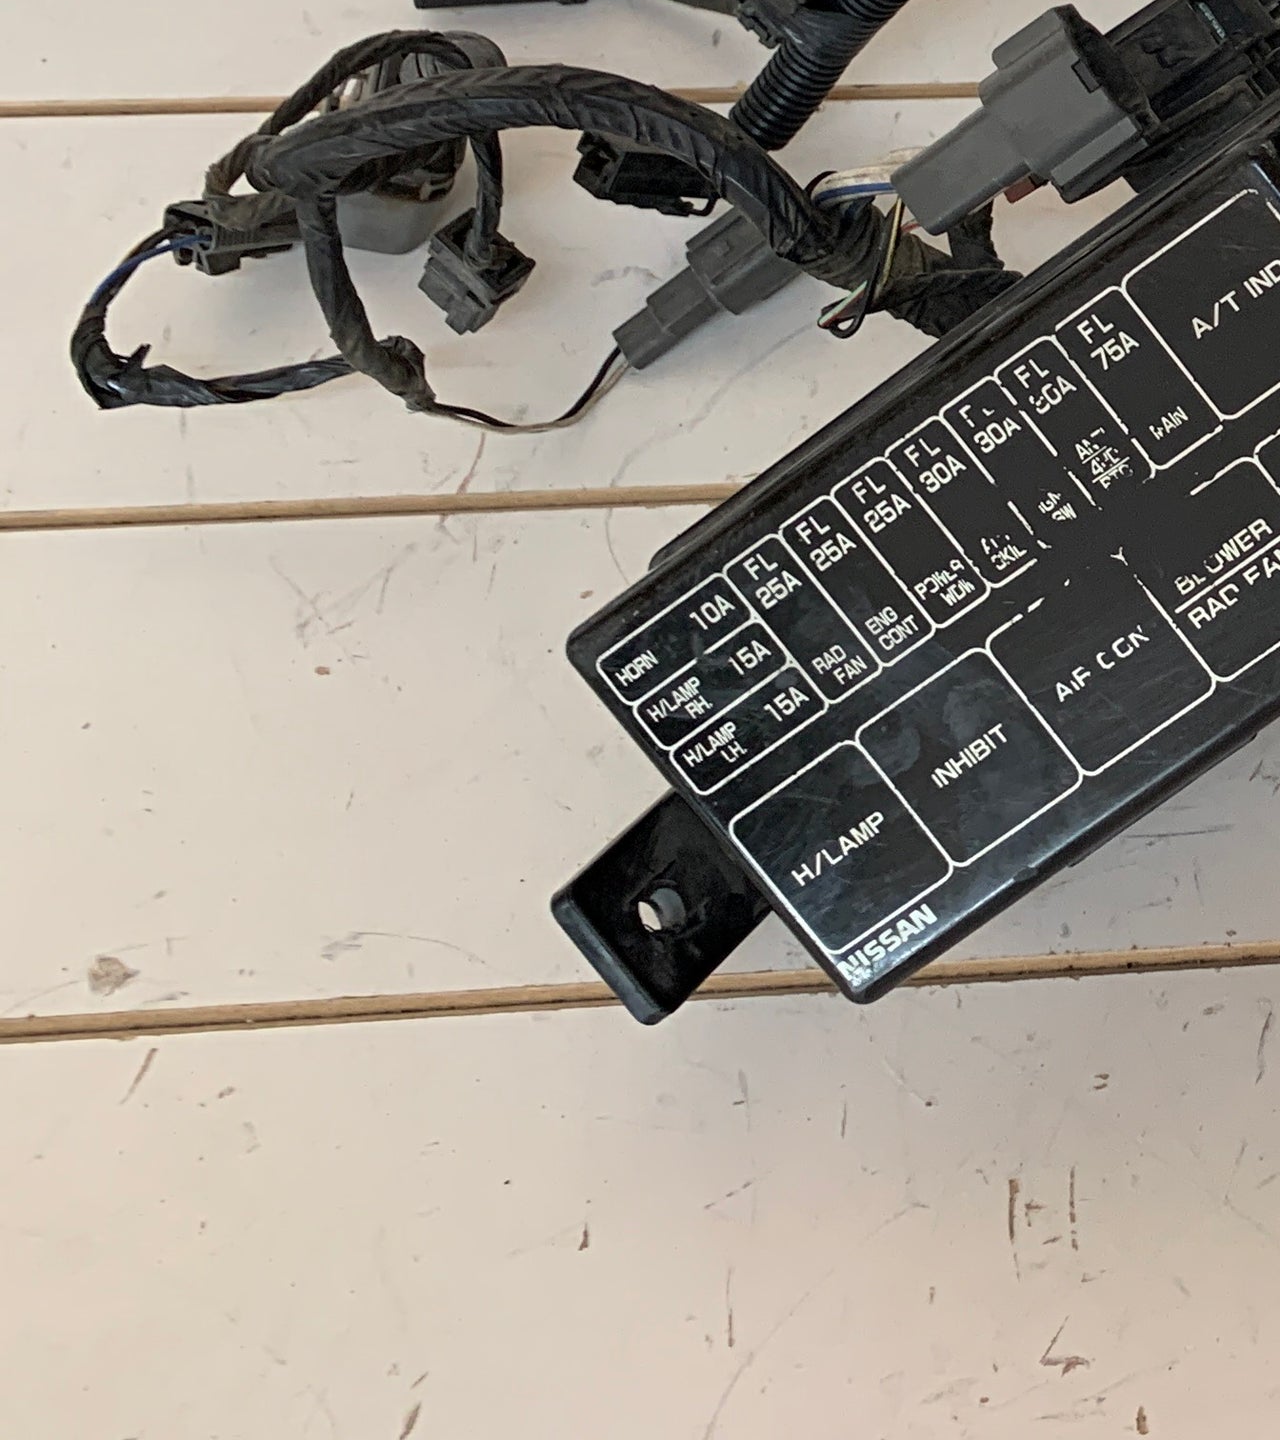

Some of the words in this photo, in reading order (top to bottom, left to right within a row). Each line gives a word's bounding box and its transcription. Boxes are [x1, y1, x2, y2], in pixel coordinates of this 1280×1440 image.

[1075, 313, 1115, 345] FL
[1190, 289, 1241, 341] A/T
[1089, 330, 1141, 372] 75A
[1012, 358, 1051, 390] FL
[902, 437, 943, 469] FL
[972, 416, 1023, 455] 30A
[850, 474, 888, 505] FL
[918, 453, 968, 495] 30A
[794, 514, 832, 546] FL
[862, 492, 913, 534] 25A
[741, 552, 780, 582] FL
[808, 531, 858, 573] 25A
[754, 569, 804, 611] 25A
[613, 648, 660, 688] HORN
[688, 593, 737, 631] 10A
[863, 605, 900, 637] ENG
[877, 613, 920, 652] CONT
[727, 639, 773, 676] 15A
[810, 643, 848, 676] RAD
[831, 653, 869, 686] FAN
[645, 675, 702, 724] H/LAMP
[762, 685, 811, 723] 15A
[681, 720, 738, 768] H/LAMP
[929, 721, 1008, 790] INHIBIT
[790, 810, 885, 888] H/LAMP
[833, 902, 939, 983] NISSAN
